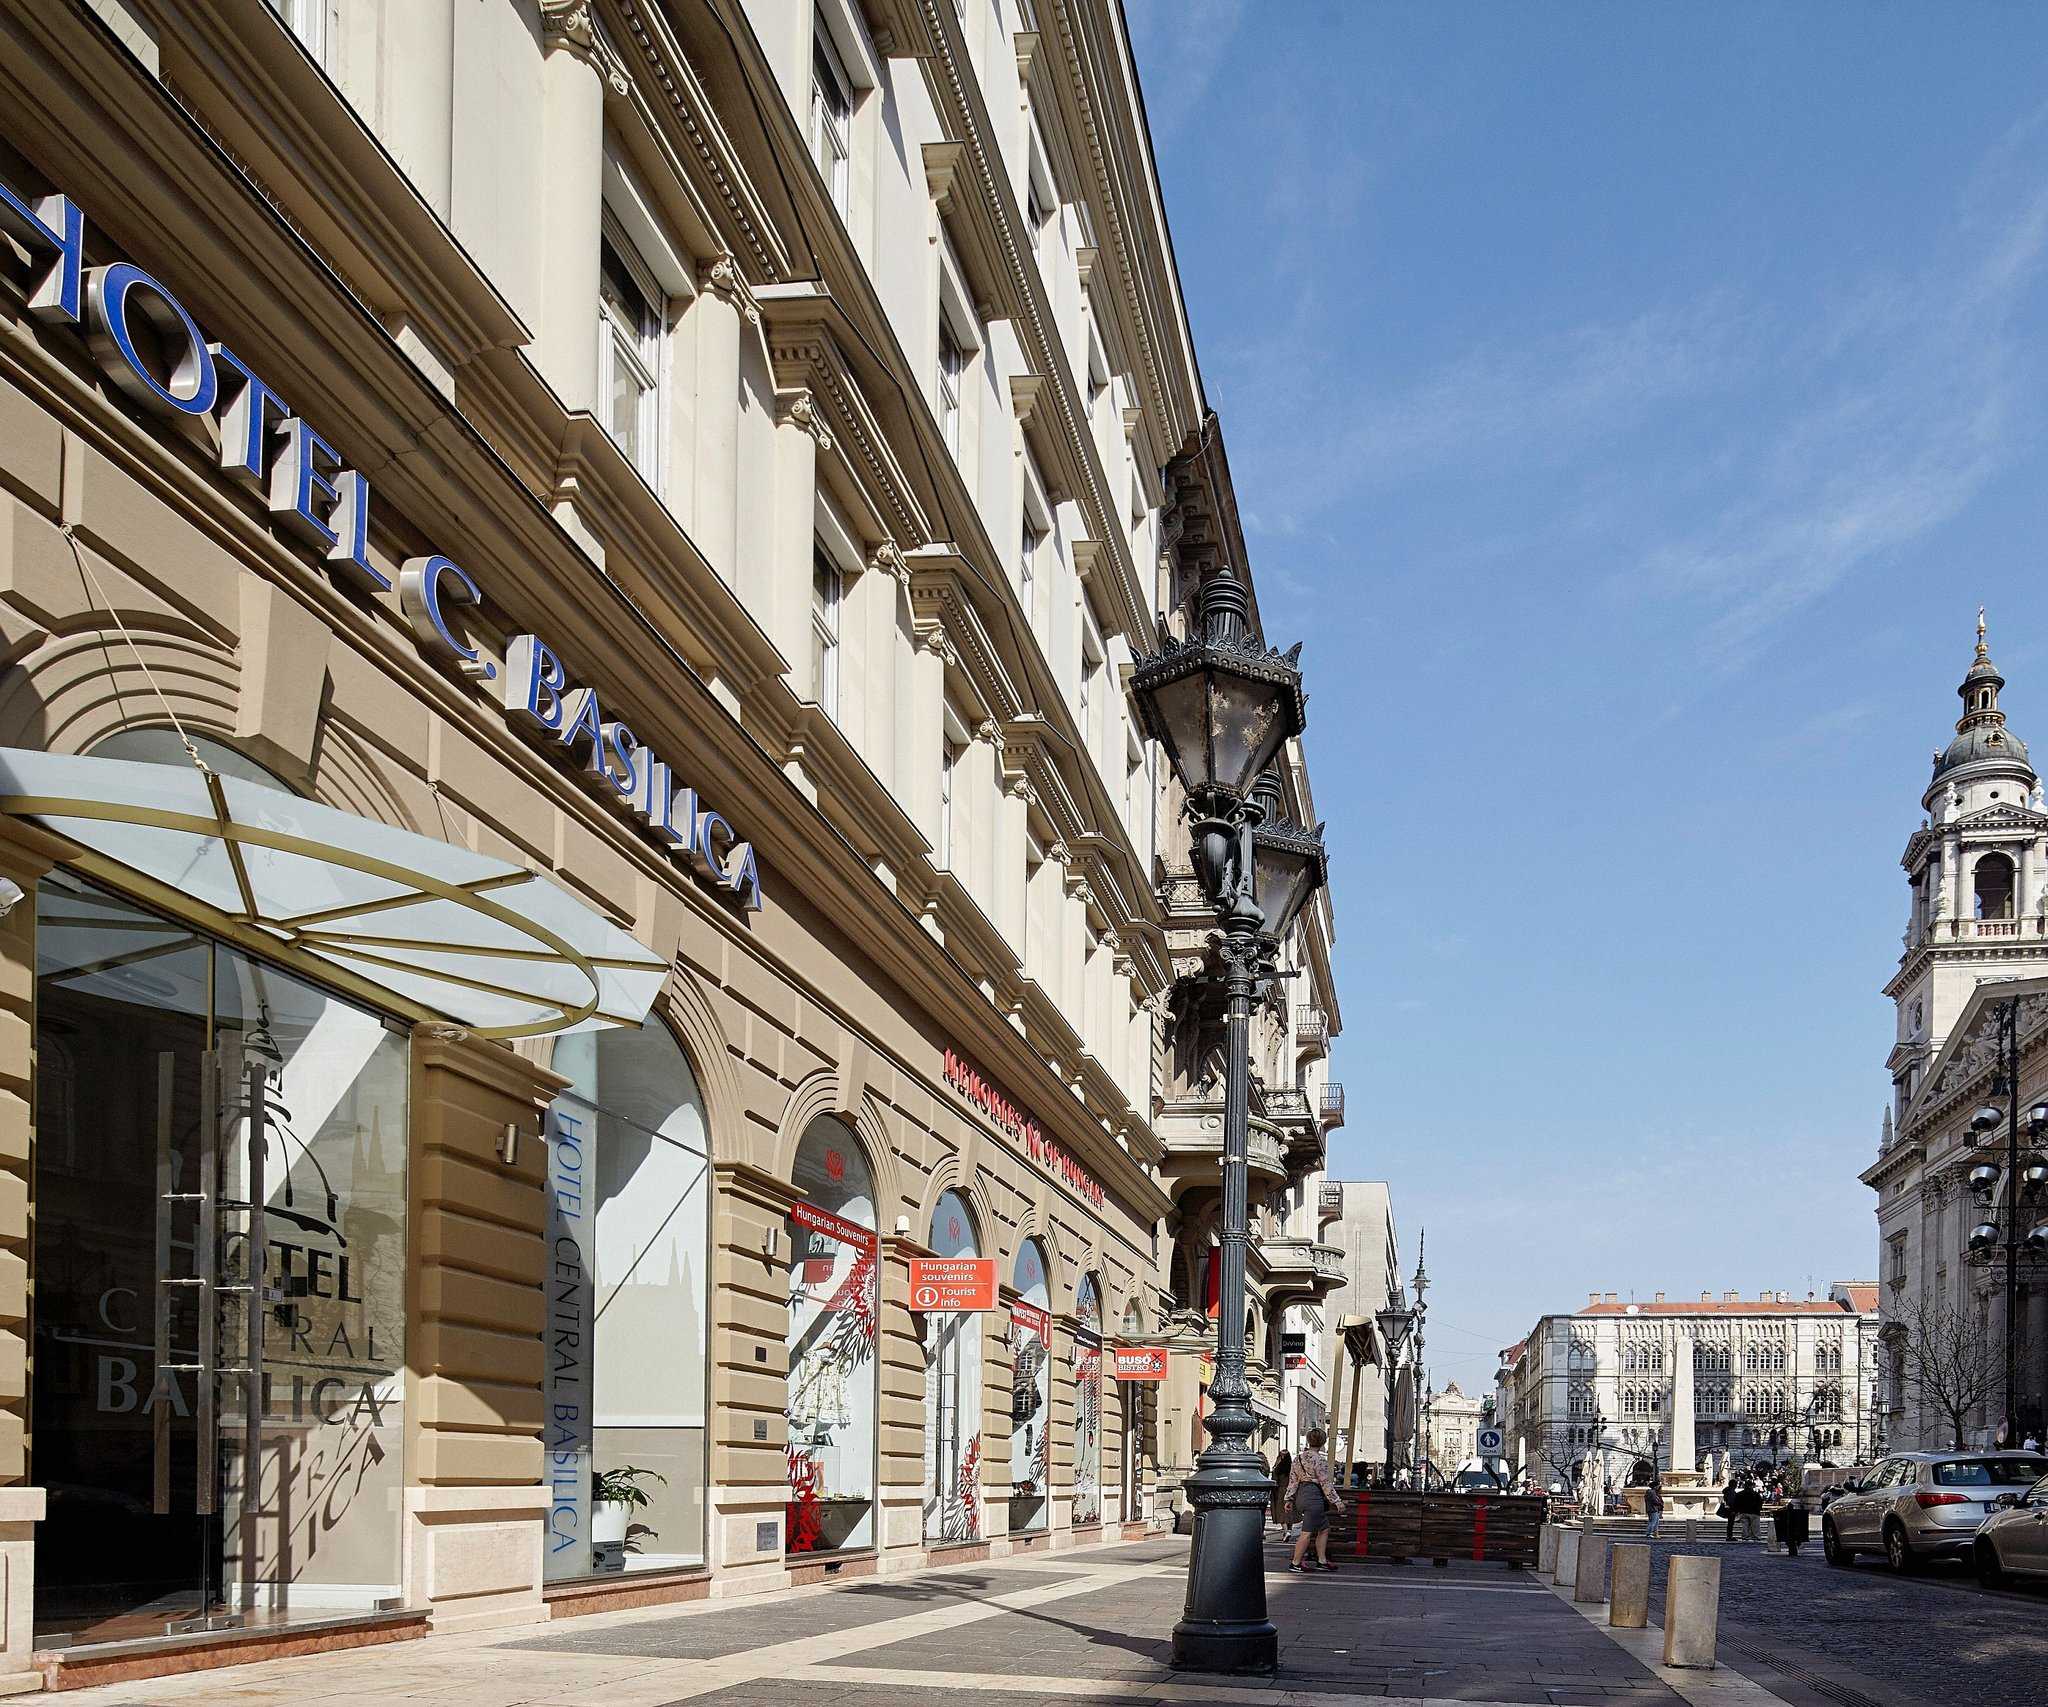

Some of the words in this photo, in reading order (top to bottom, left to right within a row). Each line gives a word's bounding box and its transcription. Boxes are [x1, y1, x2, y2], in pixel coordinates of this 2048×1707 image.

[402, 555, 497, 680] C.
[506, 634, 762, 911] BASILICA
[556, 1111, 582, 1222] HOTEL
[943, 1048, 1023, 1132] MEMORIES
[1062, 1154, 1105, 1207] HUNGARY
[796, 1206, 834, 1231] Hungarian
[836, 1223, 868, 1245] Souvenirs
[920, 1262, 976, 1272] Hungarian
[553, 1238, 580, 1390] CENTRAL
[941, 1287, 976, 1296] Tourist
[941, 1298, 960, 1307] Info
[552, 1404, 578, 1553] BASILICA
